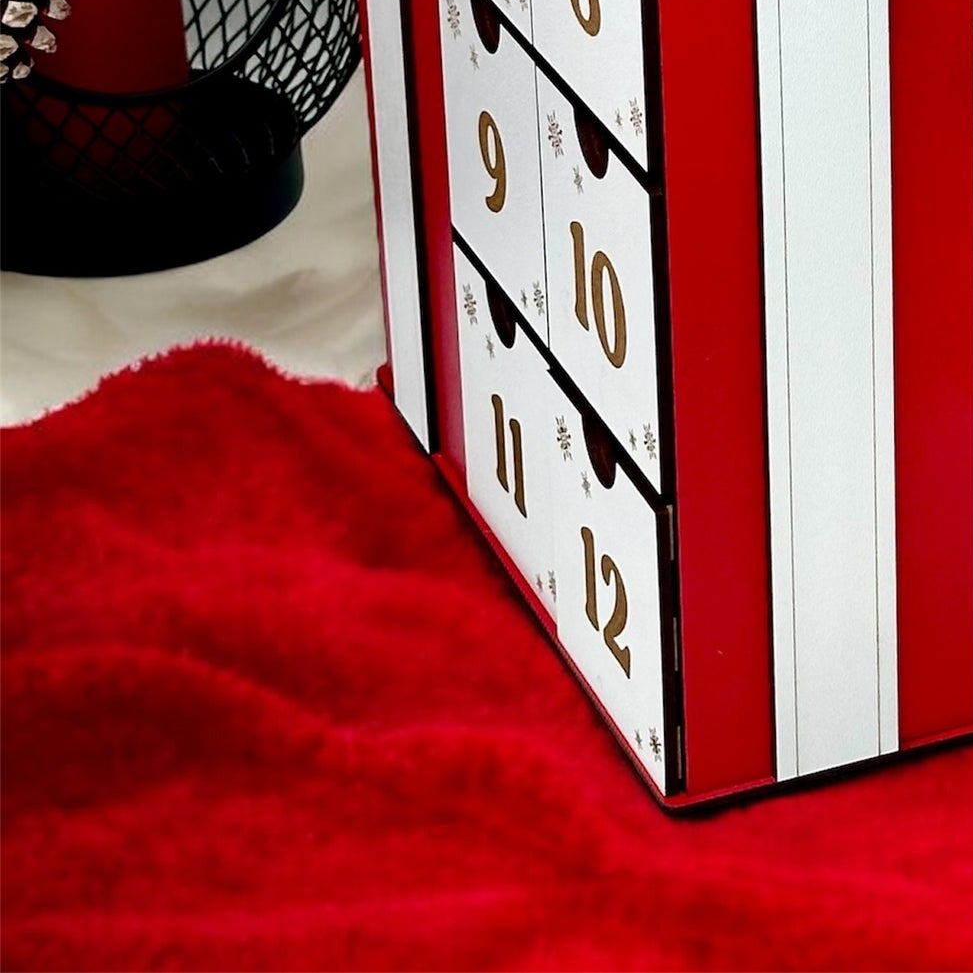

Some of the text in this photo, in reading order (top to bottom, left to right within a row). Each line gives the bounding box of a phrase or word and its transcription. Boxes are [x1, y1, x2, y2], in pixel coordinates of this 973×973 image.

[478, 110, 507, 213] 9
[569, 221, 627, 368] 10
[491, 394, 527, 518] 11
[581, 527, 631, 680] 12
